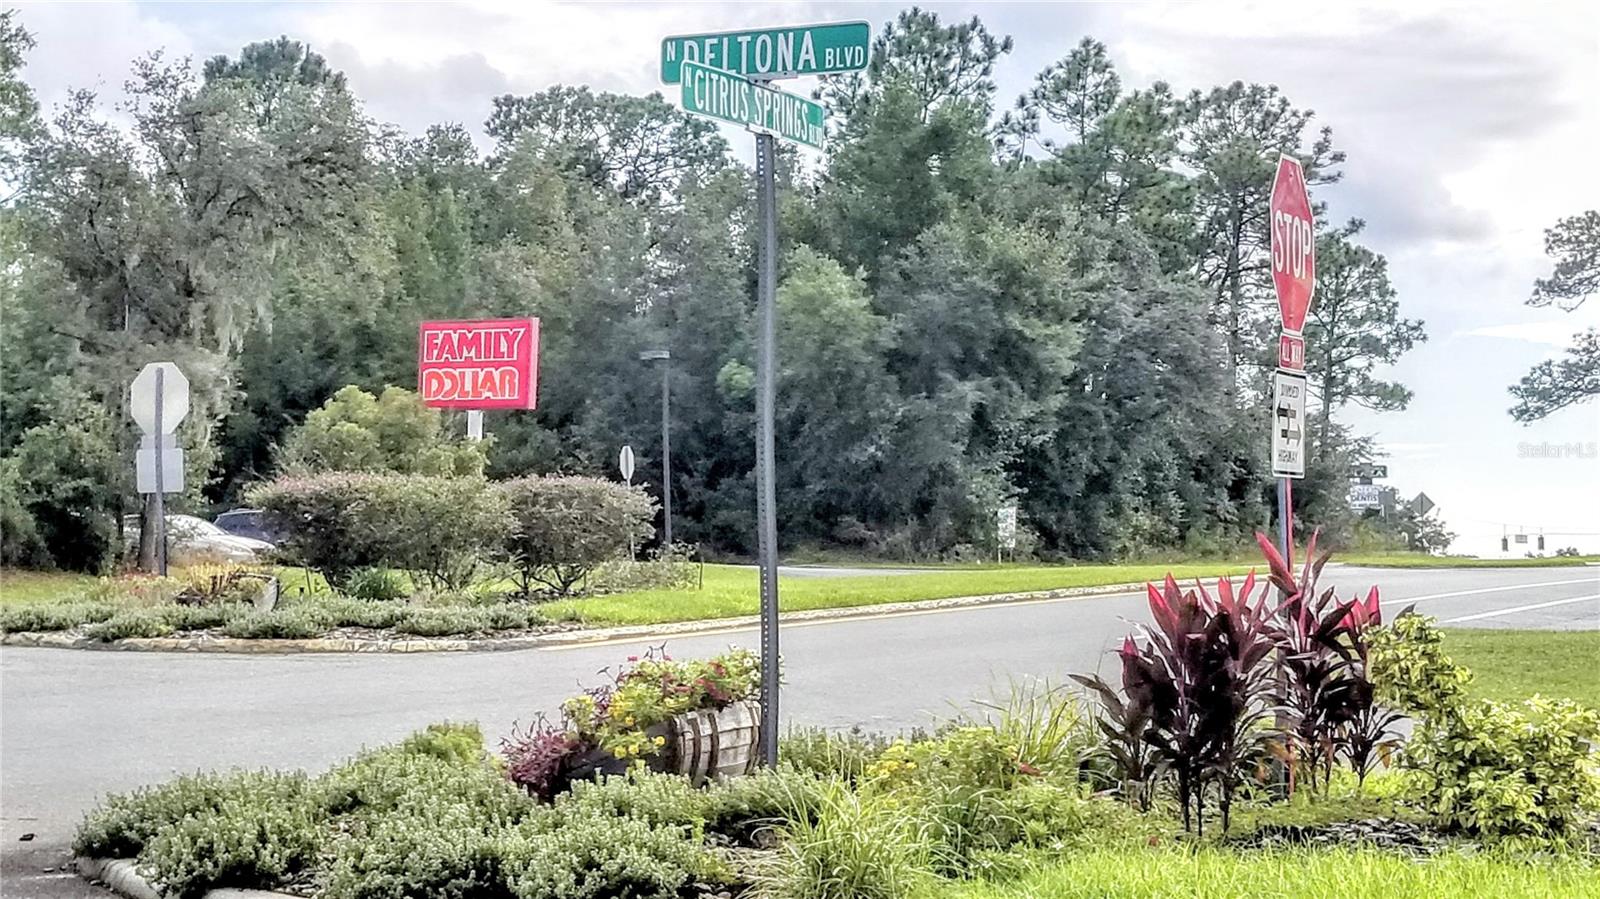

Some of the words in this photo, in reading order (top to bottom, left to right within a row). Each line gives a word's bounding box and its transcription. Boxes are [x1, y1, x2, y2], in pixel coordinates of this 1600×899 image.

[667, 41, 675, 61] N
[684, 31, 816, 75] DELTONA
[824, 46, 863, 69] BLVD
[684, 66, 692, 88] N
[694, 69, 749, 122] CITRUS
[754, 86, 808, 141] SPRINGS
[808, 123, 823, 149] BLVD
[1274, 210, 1311, 280] STOP
[424, 328, 526, 362] FAMILY
[423, 366, 519, 400] DOLLAR
